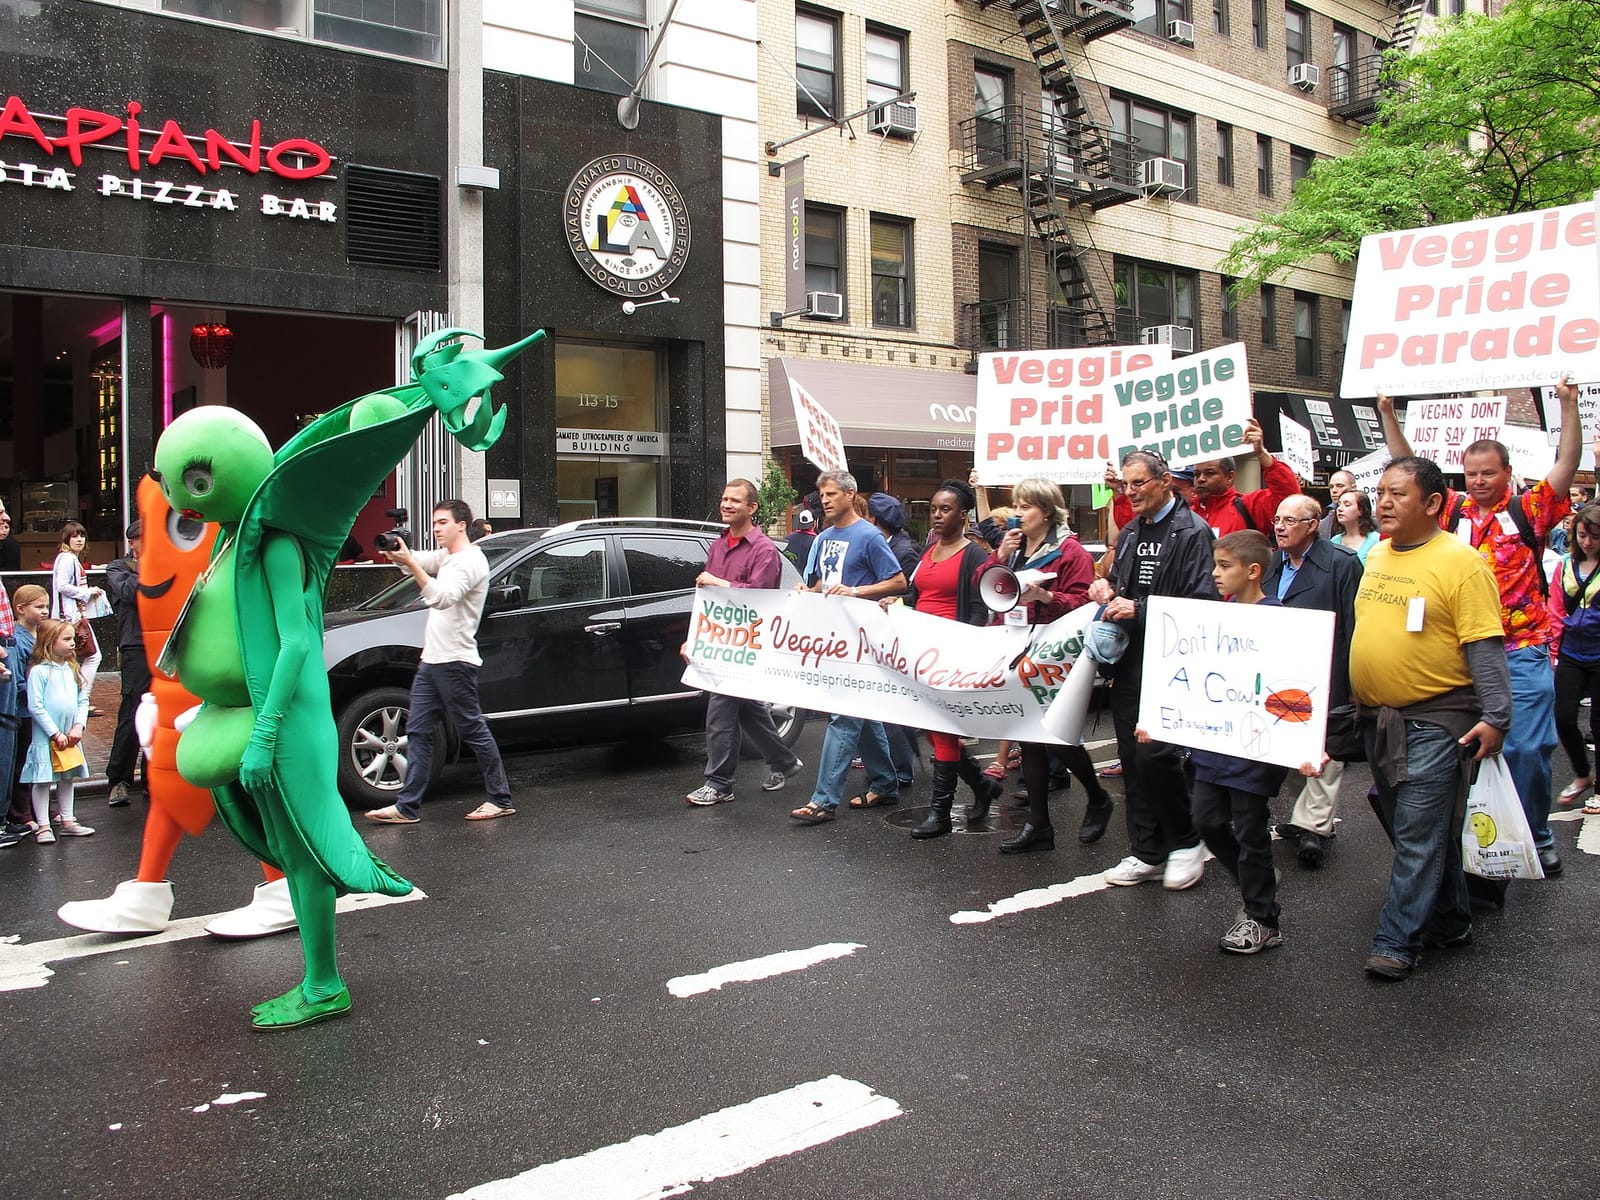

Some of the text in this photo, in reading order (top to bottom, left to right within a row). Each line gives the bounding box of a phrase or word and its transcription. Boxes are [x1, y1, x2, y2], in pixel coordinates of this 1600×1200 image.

[102, 174, 237, 212] PIZZA
[262, 194, 337, 223] BAR
[567, 158, 688, 267] AMALGAMATED LITHOGRAPHERS
[789, 196, 800, 271] nanoosh
[1378, 211, 1596, 271] Veggie
[589, 263, 668, 294] LOCAL ONE
[1394, 271, 1571, 322] Pride
[1359, 316, 1600, 370] Parade
[1114, 356, 1236, 407] Veggie
[578, 393, 618, 409] 113-15
[797, 387, 839, 441] Veggie
[1009, 394, 1103, 426] Prid
[1131, 397, 1224, 438] Pride
[1421, 402, 1501, 420] VEGANS DONT
[572, 441, 631, 452] BUILDING
[582, 433, 624, 442] LITHOGRAPHERS
[626, 434, 634, 442] OF
[636, 435, 659, 443] AMERICA
[807, 419, 840, 461] Pride
[1413, 426, 1500, 443] JUST SAY THEY
[1414, 449, 1440, 464] OVE
[703, 600, 758, 626] Veggie
[1359, 588, 1408, 607] EGETARIAN
[695, 610, 763, 650] PRIDE
[769, 615, 849, 669] Veggie
[856, 626, 909, 676] Pride
[1030, 629, 1085, 661] Veggi
[1162, 611, 1260, 658] Don't have
[691, 639, 757, 667] Parade
[763, 666, 919, 702] www.veggieprideparade.org
[1167, 666, 1262, 706] A Cow!
[973, 701, 1025, 718] Society
